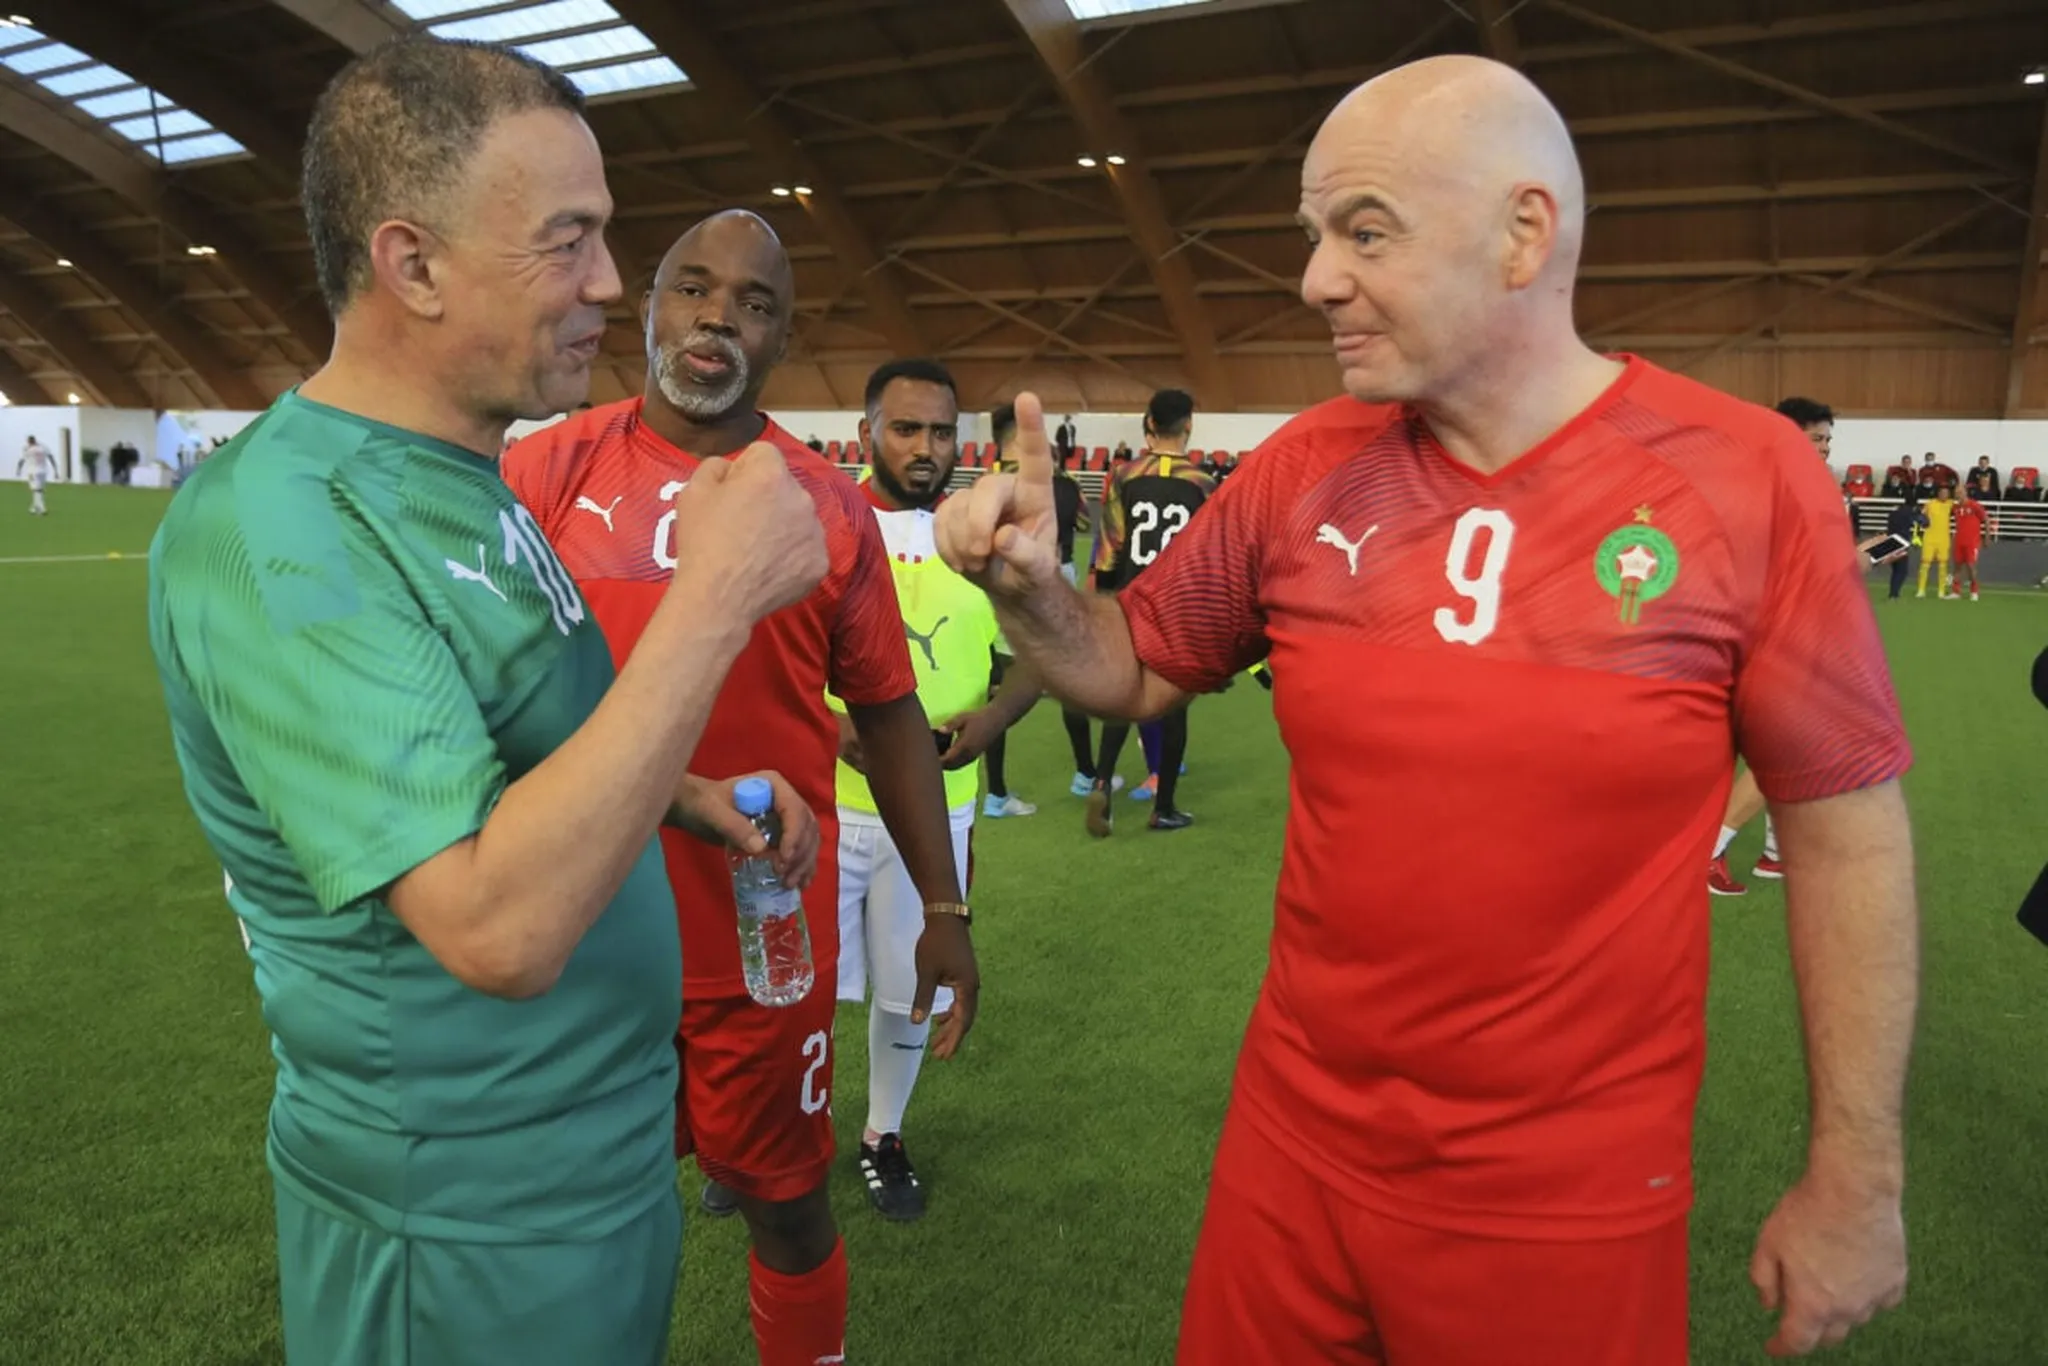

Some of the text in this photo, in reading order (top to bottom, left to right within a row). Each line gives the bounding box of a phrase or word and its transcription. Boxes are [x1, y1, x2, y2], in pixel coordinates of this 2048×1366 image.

[499, 502, 584, 636] 10
[1131, 501, 1190, 565] 22
[1433, 507, 1516, 645] 9
[801, 1029, 834, 1116] 2
